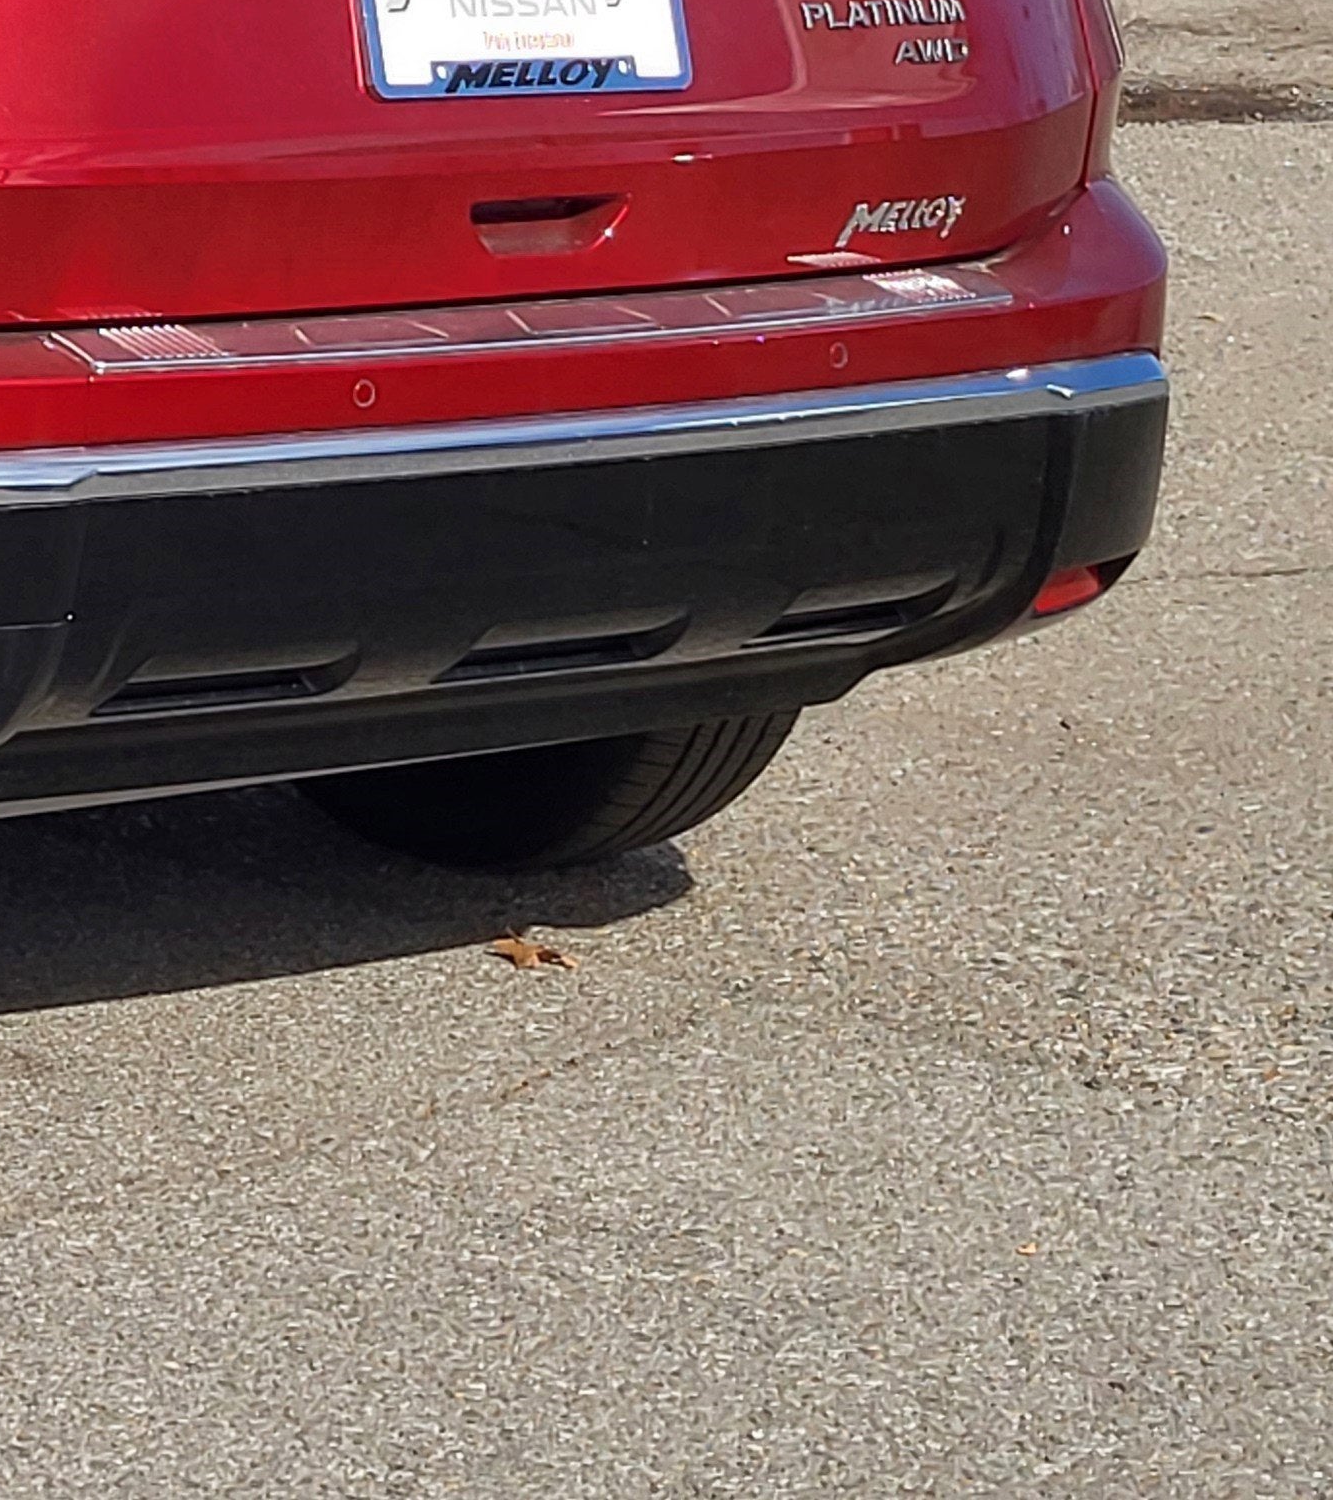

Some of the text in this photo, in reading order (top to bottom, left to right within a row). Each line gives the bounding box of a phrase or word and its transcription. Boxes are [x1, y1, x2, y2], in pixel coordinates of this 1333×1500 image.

[895, 38, 969, 65] AWD
[445, 58, 616, 93] MELLOY
[835, 195, 967, 248] MELLOY
